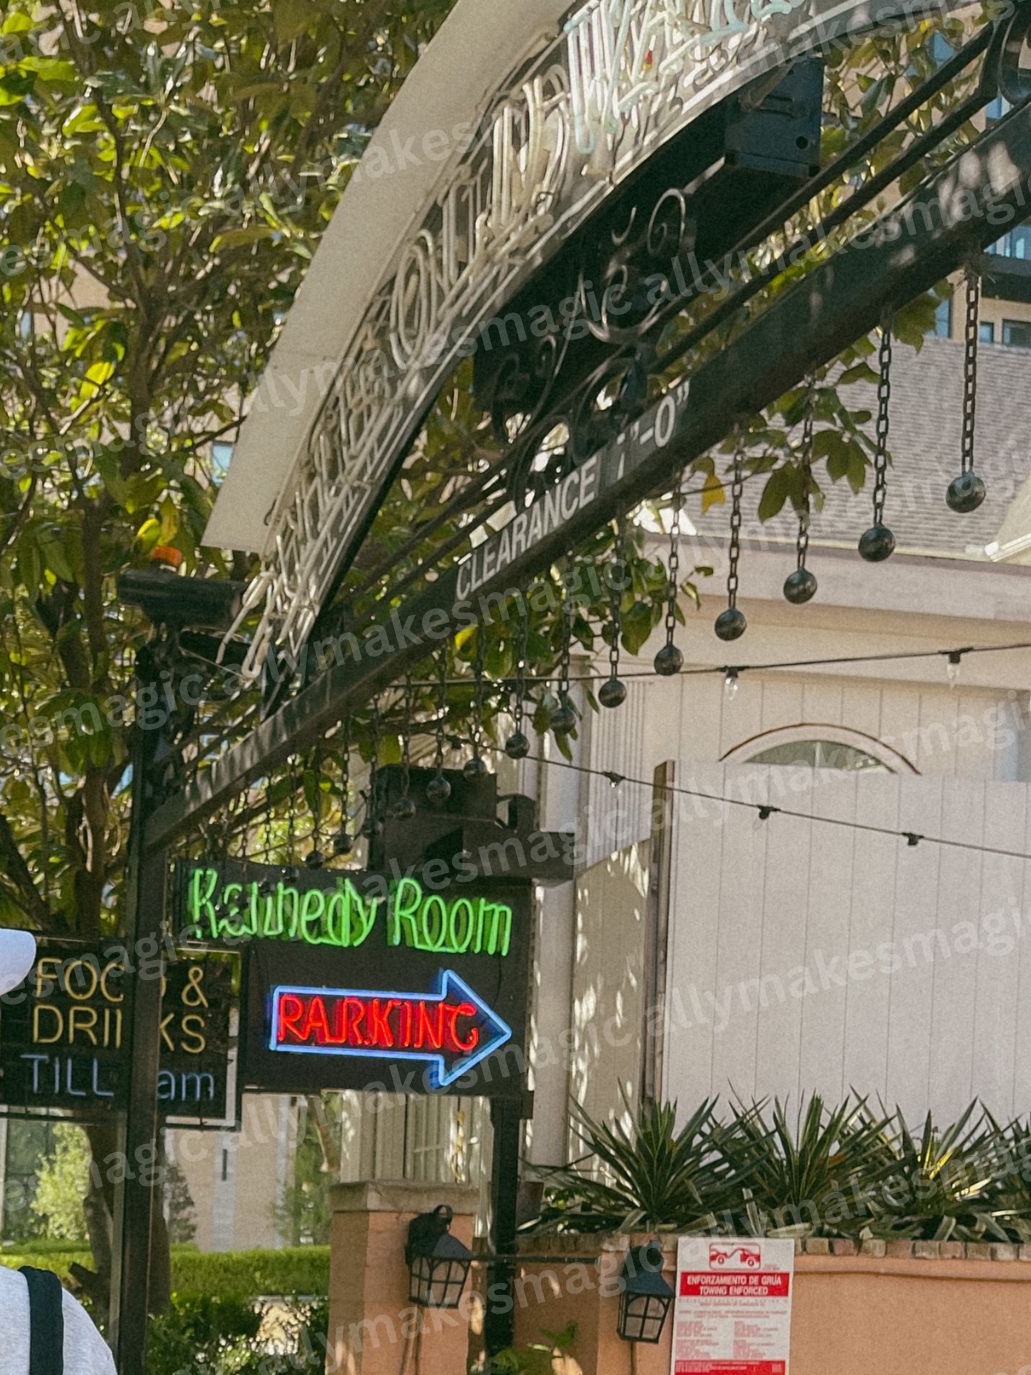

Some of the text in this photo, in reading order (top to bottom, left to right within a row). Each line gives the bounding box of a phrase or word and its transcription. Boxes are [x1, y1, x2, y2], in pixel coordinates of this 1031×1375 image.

[456, 454, 596, 600] CLEARANCE
[392, 877, 512, 956] Room
[36, 958, 209, 1008] FOO &
[33, 1004, 206, 1053] DRIKS
[20, 1053, 115, 1097] TILL
[700, 1286, 768, 1295] TOWING ENFORCED
[749, 1275, 760, 1285] DE
